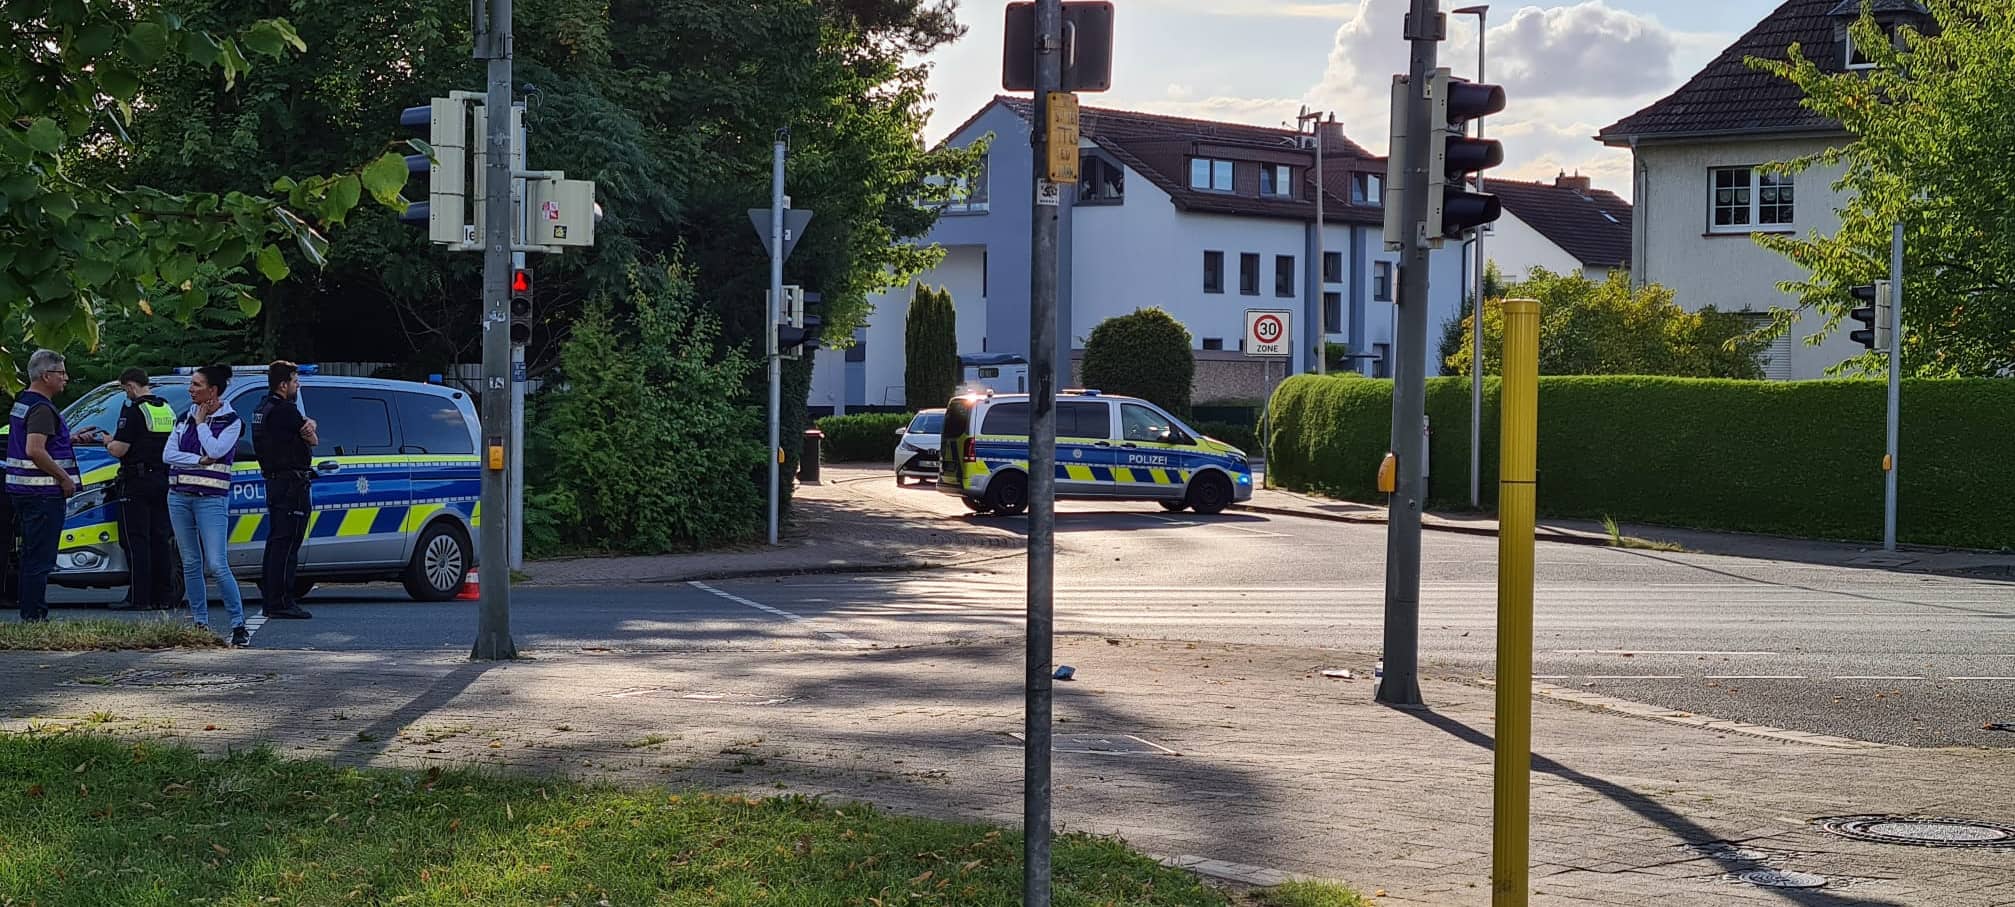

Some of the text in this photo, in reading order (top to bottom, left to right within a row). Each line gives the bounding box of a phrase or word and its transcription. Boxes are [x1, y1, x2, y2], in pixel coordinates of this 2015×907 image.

[1260, 322, 1277, 336] 30
[1256, 344, 1280, 353] ZONE
[1128, 454, 1168, 465] POLIZEI
[233, 483, 267, 500] POLI
